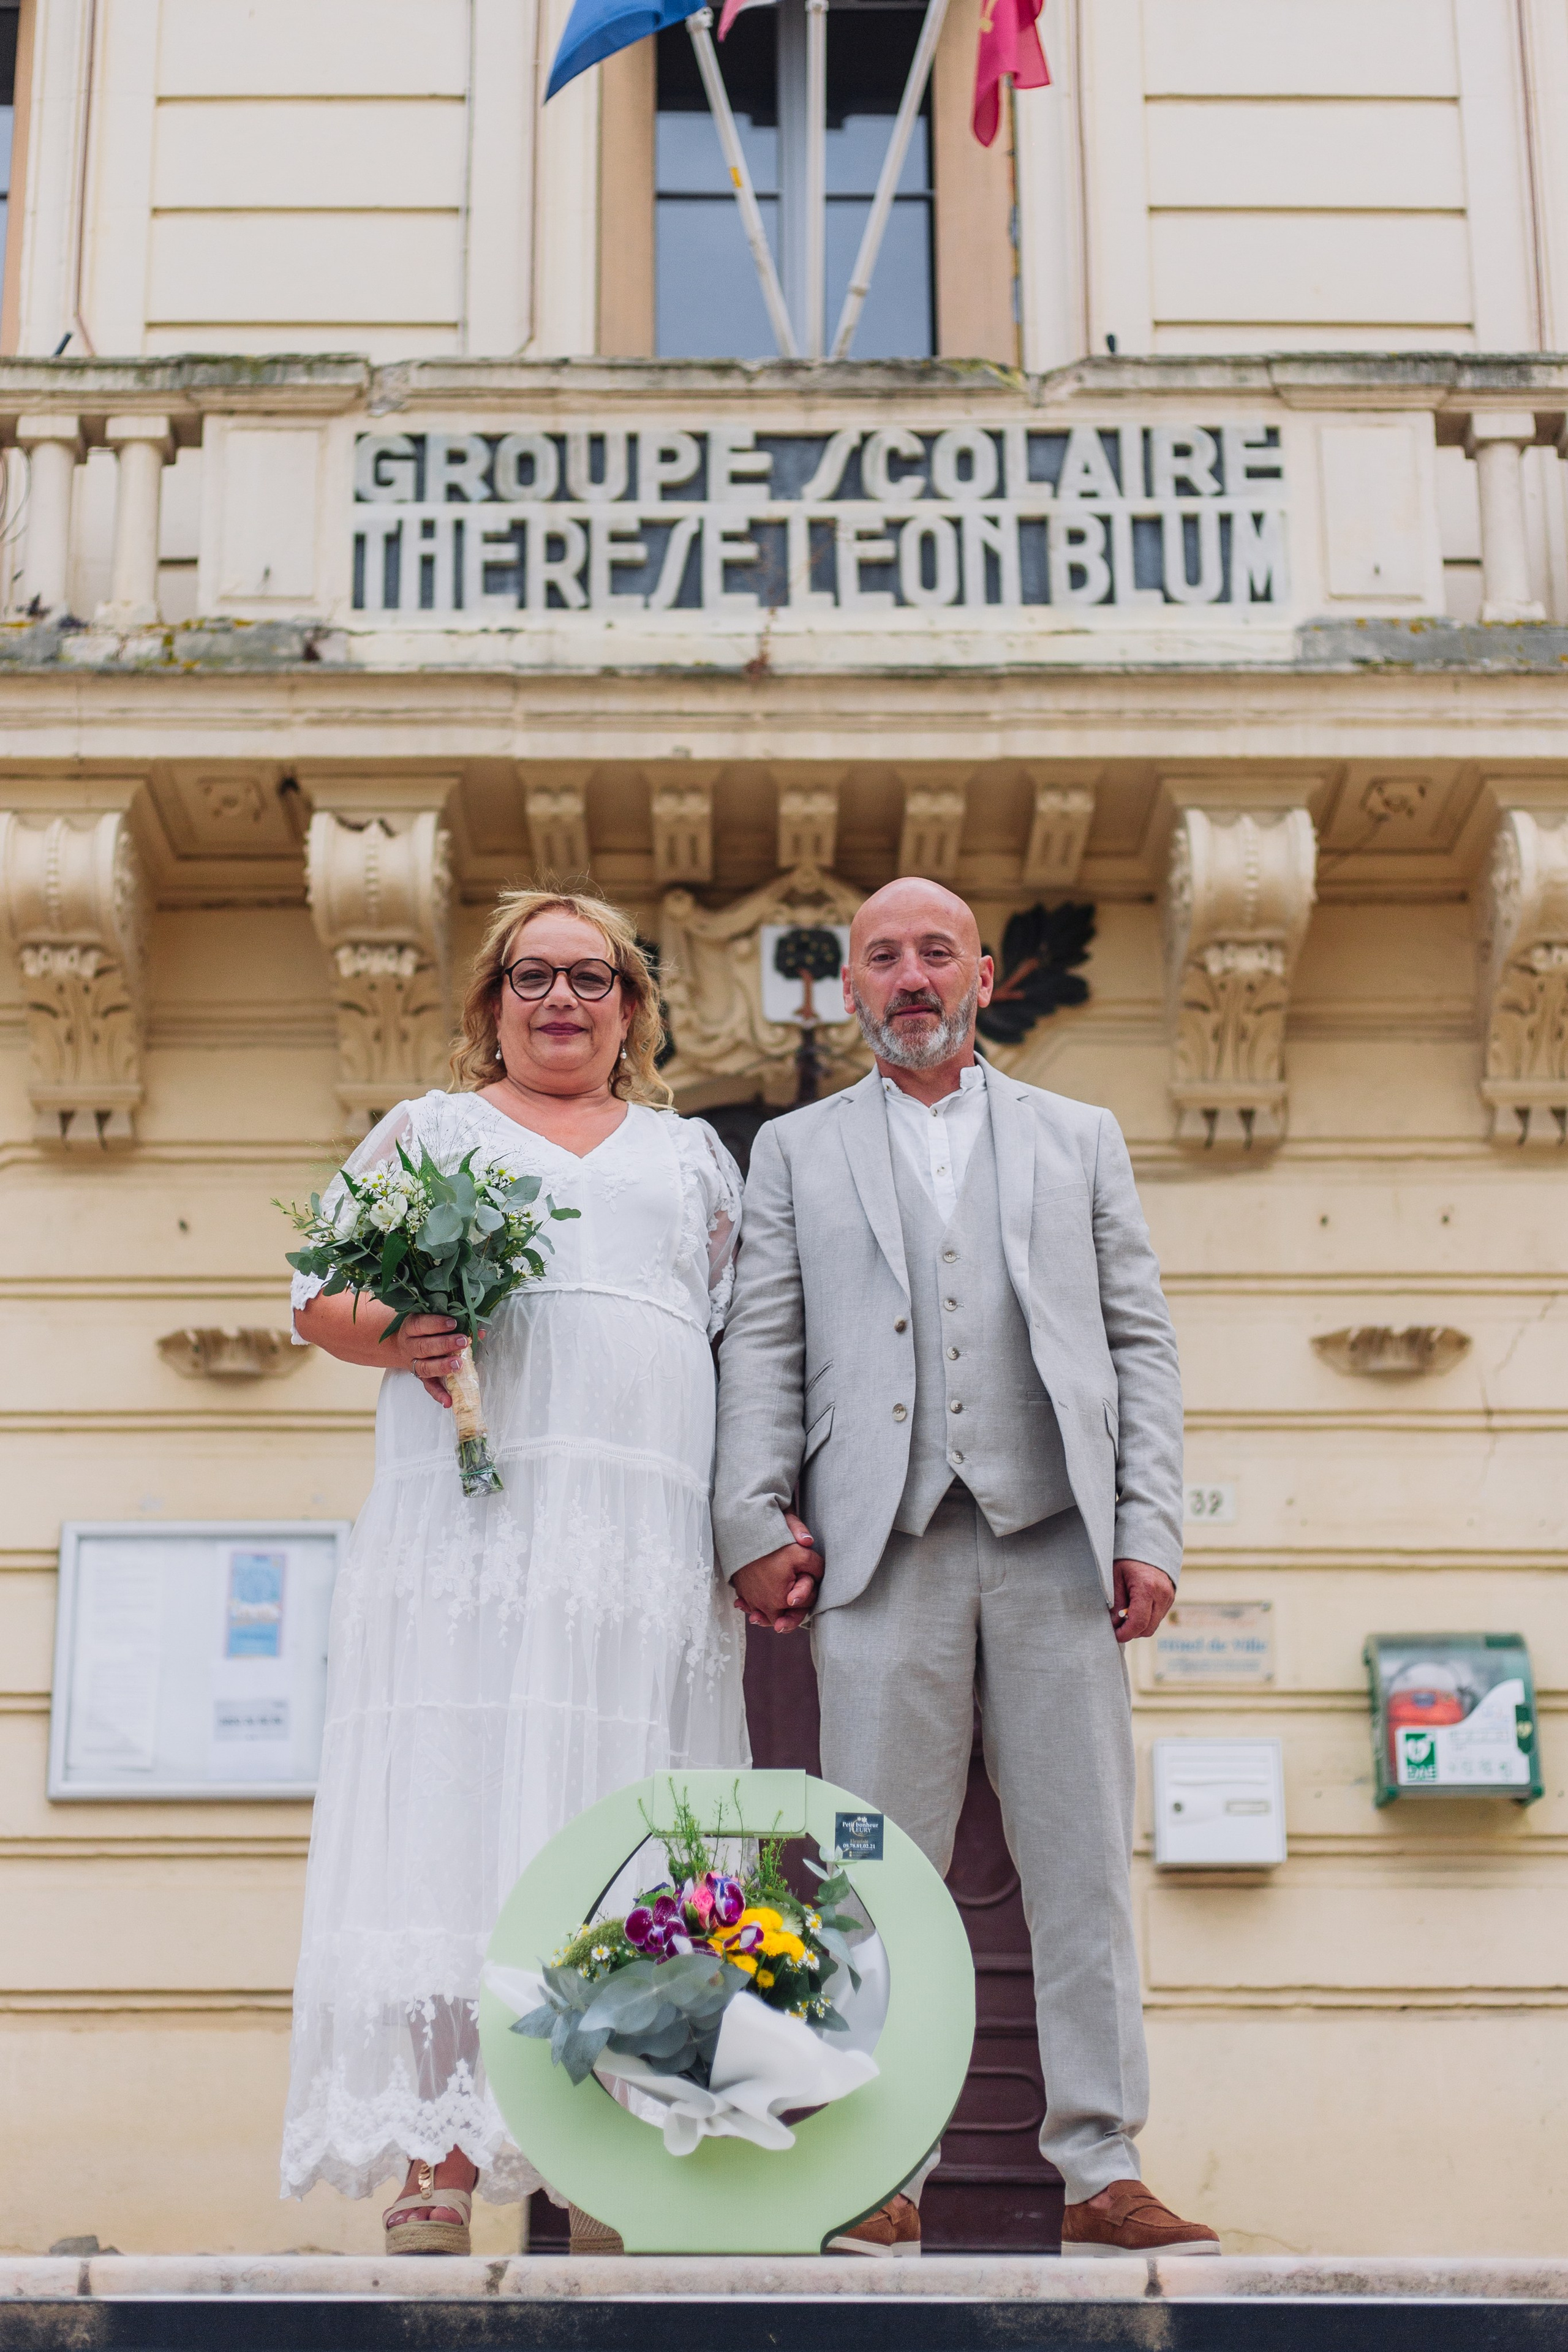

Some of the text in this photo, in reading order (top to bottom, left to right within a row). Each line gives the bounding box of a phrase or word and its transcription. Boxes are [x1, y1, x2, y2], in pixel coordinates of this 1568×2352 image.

[355, 421, 1286, 502] GROUPE SCOLAIRE
[354, 511, 1289, 609] THERESE LEON BLUM
